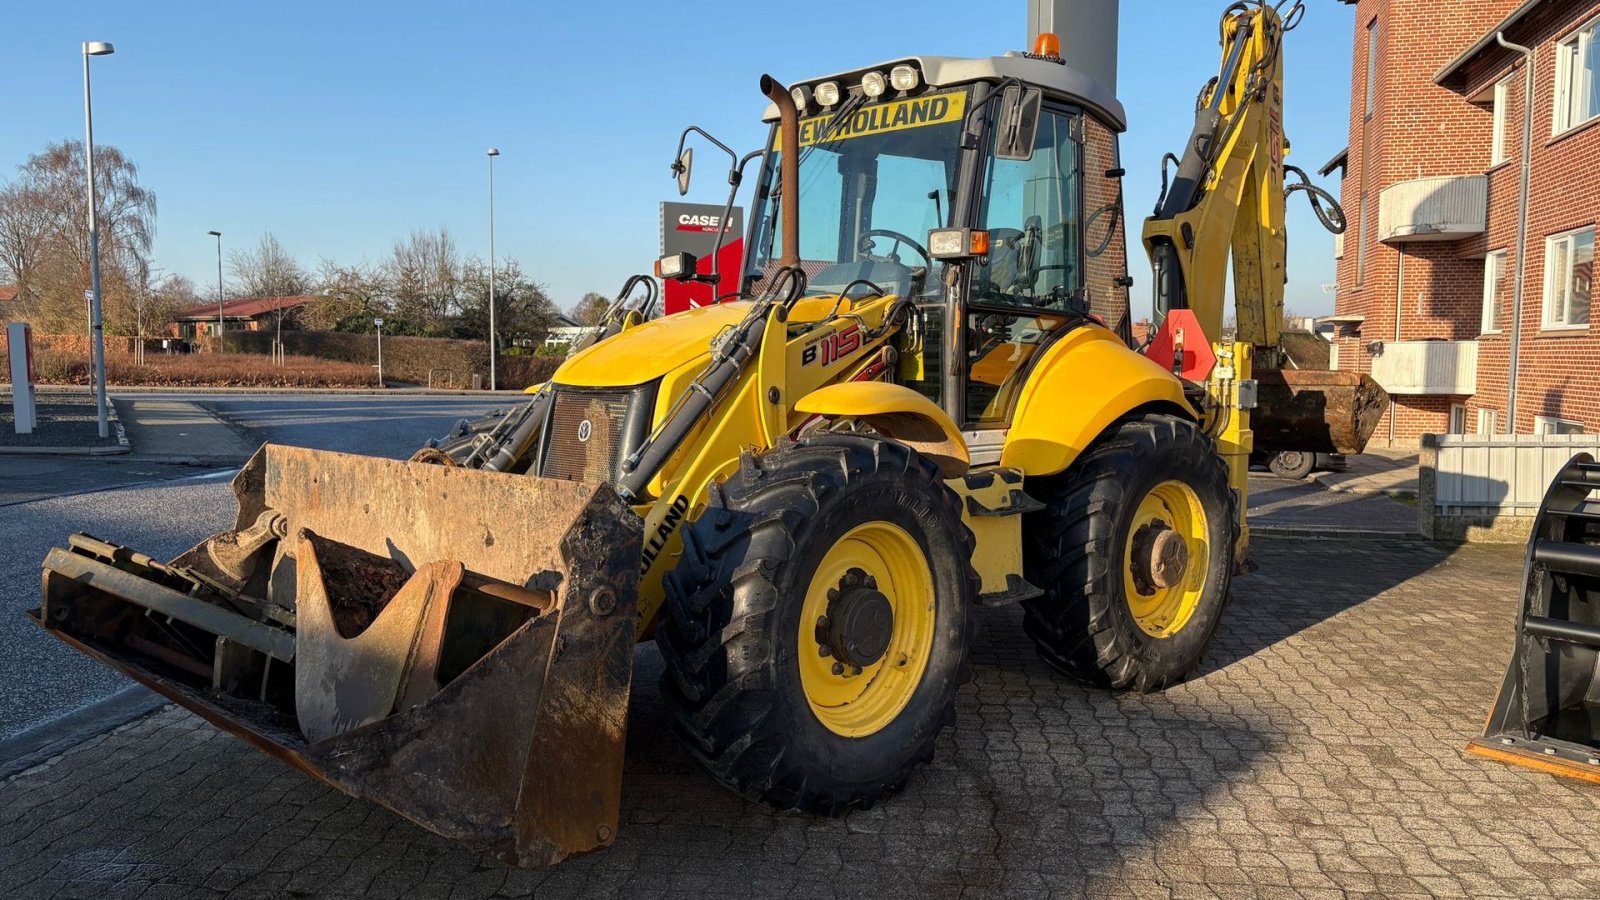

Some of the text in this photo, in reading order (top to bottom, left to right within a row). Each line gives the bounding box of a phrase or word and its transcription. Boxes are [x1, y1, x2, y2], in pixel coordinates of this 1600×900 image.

[800, 117, 833, 143] EW
[679, 214, 719, 226] CASE
[802, 345, 816, 367] B
[821, 324, 860, 366] 115
